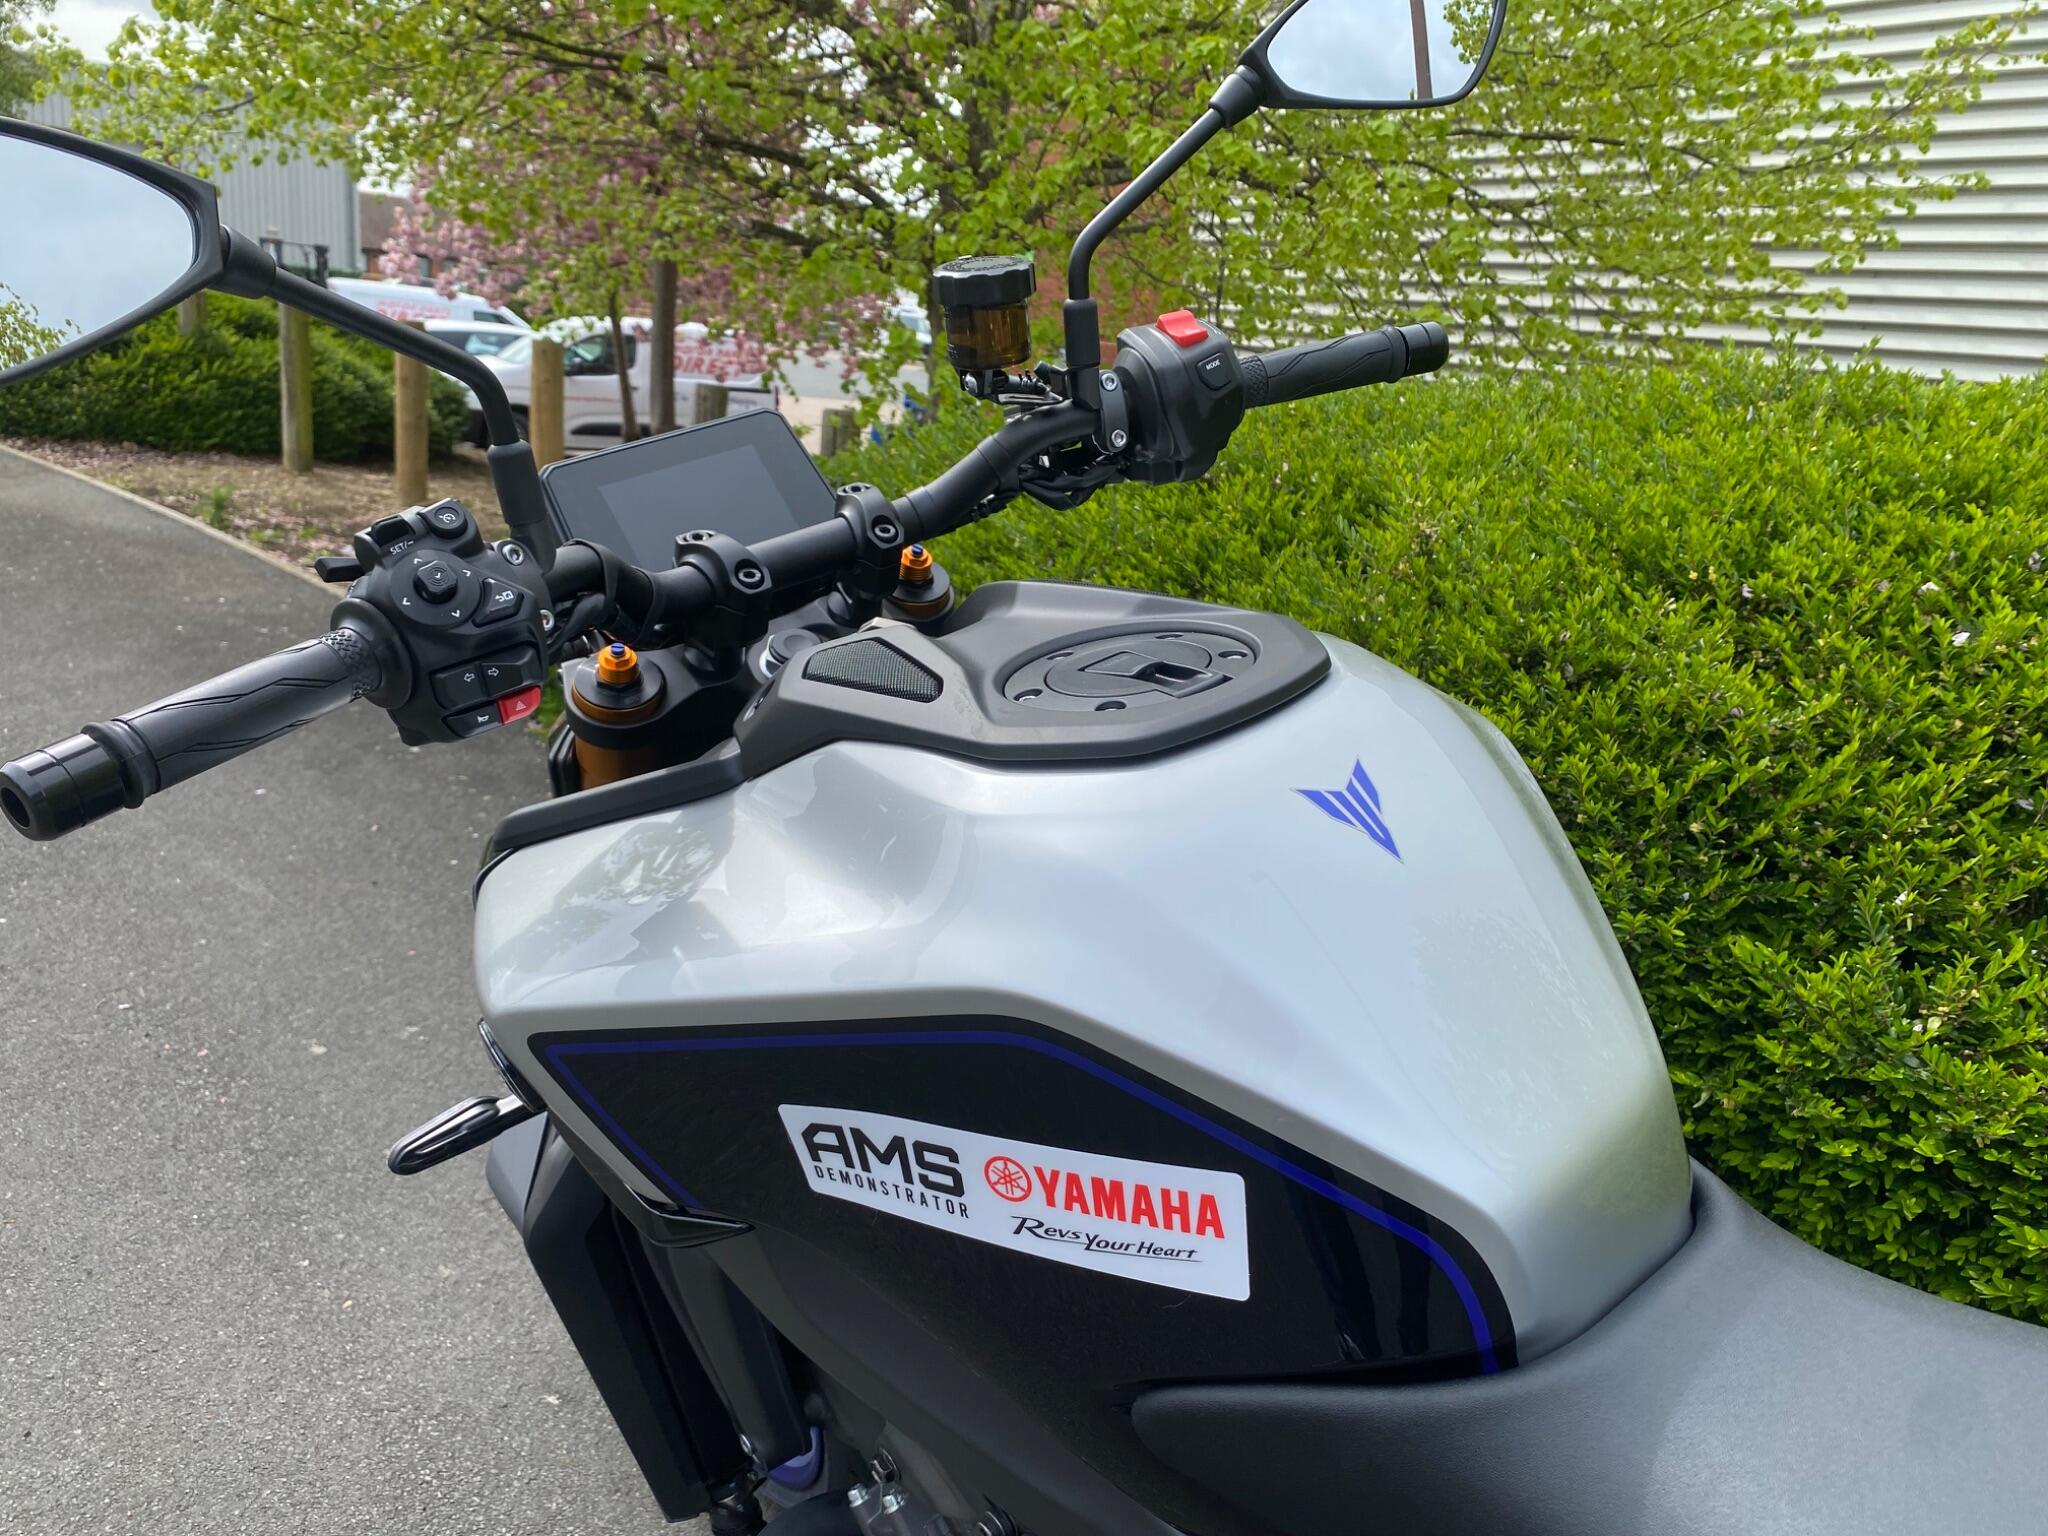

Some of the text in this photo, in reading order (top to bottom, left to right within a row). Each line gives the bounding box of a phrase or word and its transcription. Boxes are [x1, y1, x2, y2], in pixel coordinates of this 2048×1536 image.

[801, 1122, 965, 1198] AMS
[813, 1165, 970, 1219] DEMONSTRATOR
[1034, 1166, 1225, 1239] YAMAHA
[1010, 1216, 1198, 1259] Revs Your Heart
